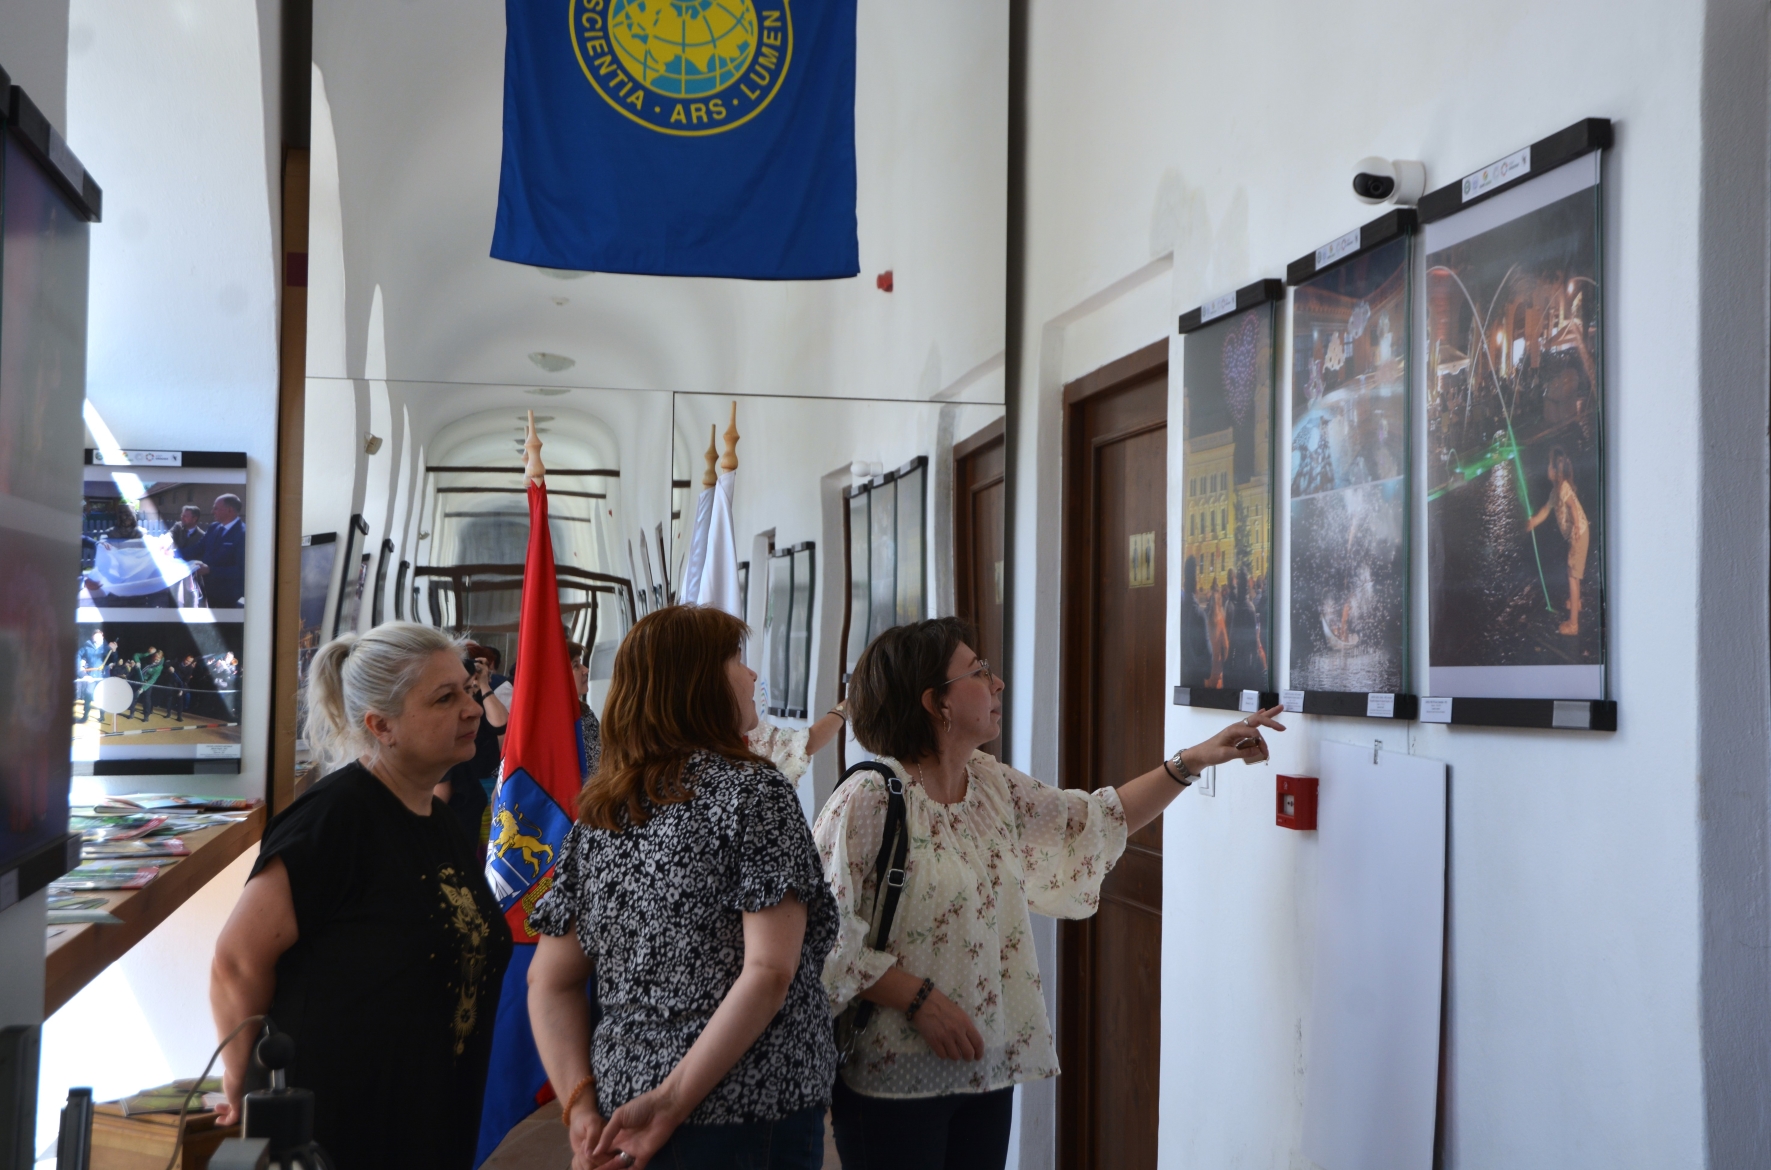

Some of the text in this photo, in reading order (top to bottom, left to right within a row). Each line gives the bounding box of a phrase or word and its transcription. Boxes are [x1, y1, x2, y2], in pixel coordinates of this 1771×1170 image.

[581, 0, 782, 124] SCIENTIA ARS LUMEN
